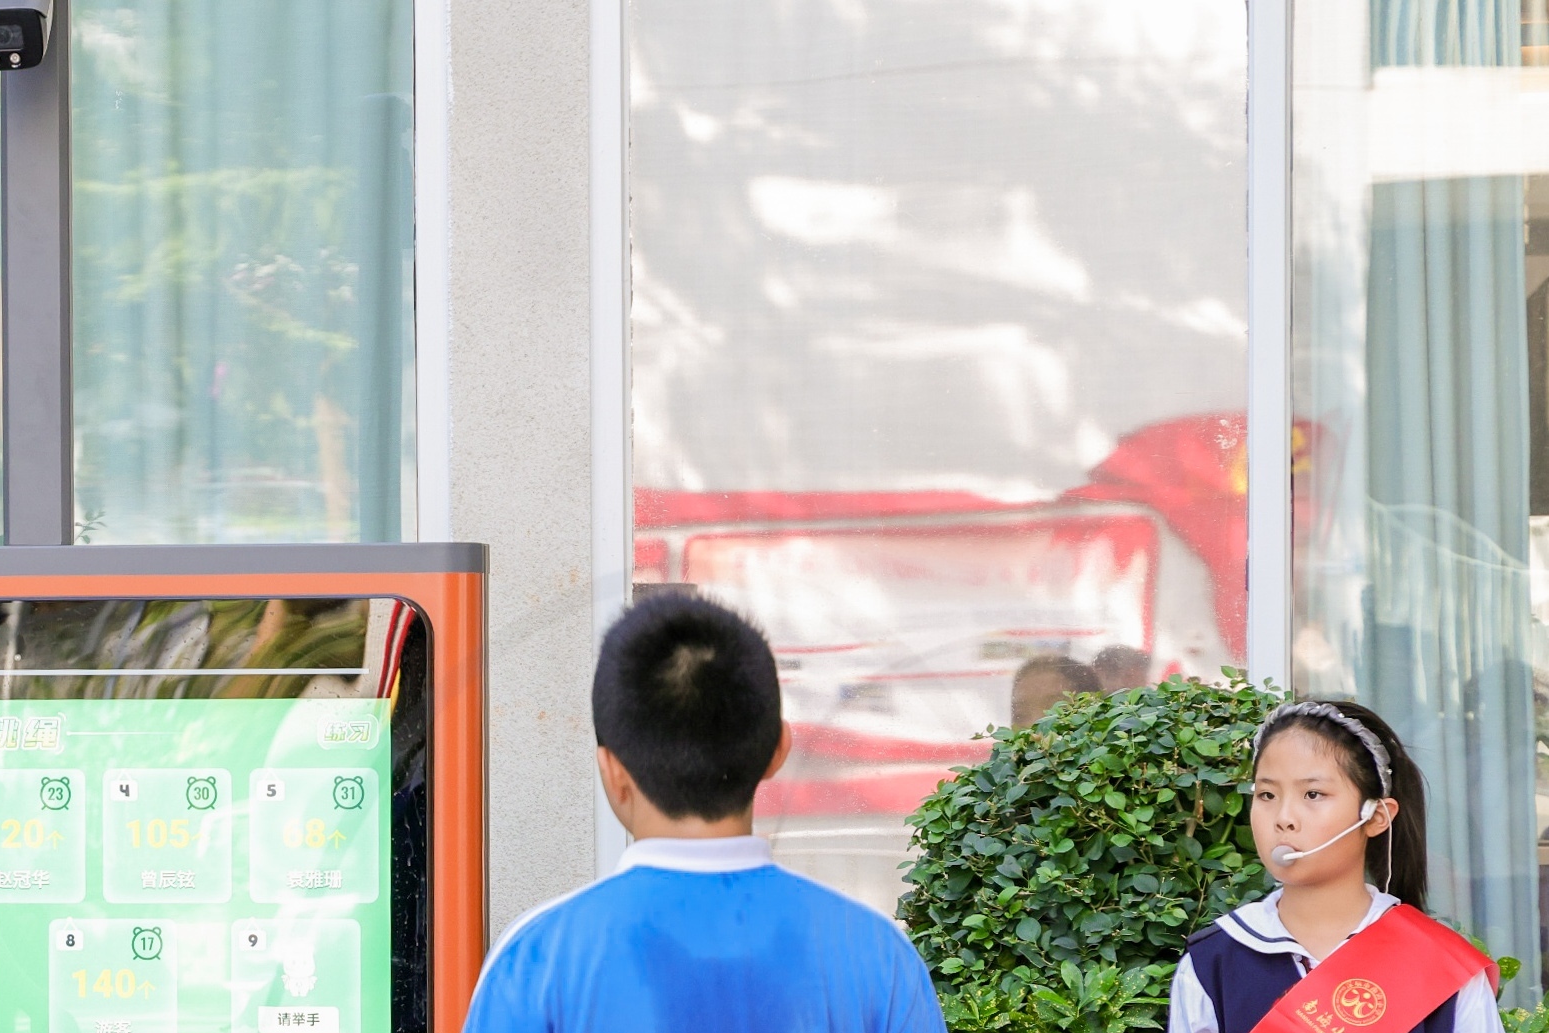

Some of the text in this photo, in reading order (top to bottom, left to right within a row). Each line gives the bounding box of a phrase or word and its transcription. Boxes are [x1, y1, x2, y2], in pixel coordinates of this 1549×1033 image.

[48, 787, 63, 801] 23
[119, 784, 130, 797] 4
[193, 786, 210, 800] 30
[266, 784, 277, 797] 5
[341, 786, 355, 800] 31
[65, 934, 76, 947] 8
[140, 937, 155, 951] 17
[248, 934, 258, 947] 9
[277, 1012, 320, 1027] 请举手
